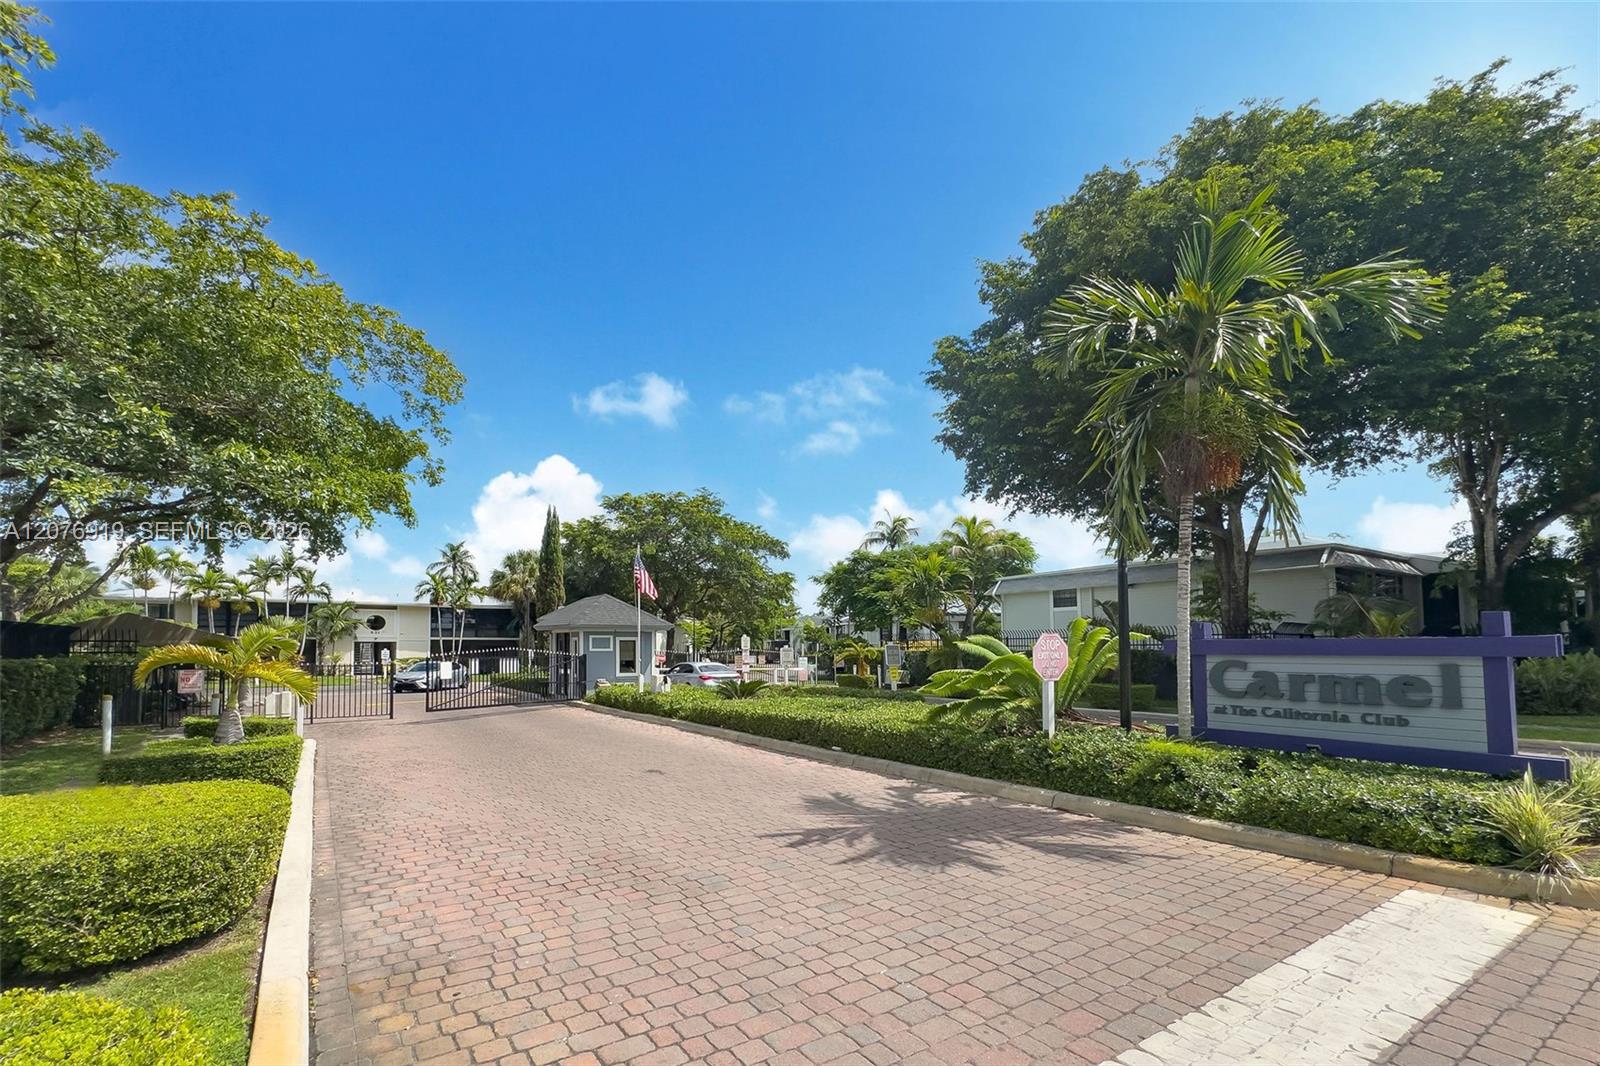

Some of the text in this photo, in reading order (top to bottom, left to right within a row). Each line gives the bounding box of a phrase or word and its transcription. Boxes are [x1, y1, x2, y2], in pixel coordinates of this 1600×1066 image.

[1040, 639, 1060, 650] STOP
[1209, 660, 1463, 709] Carmel
[1213, 704, 1410, 727] at The California Club
